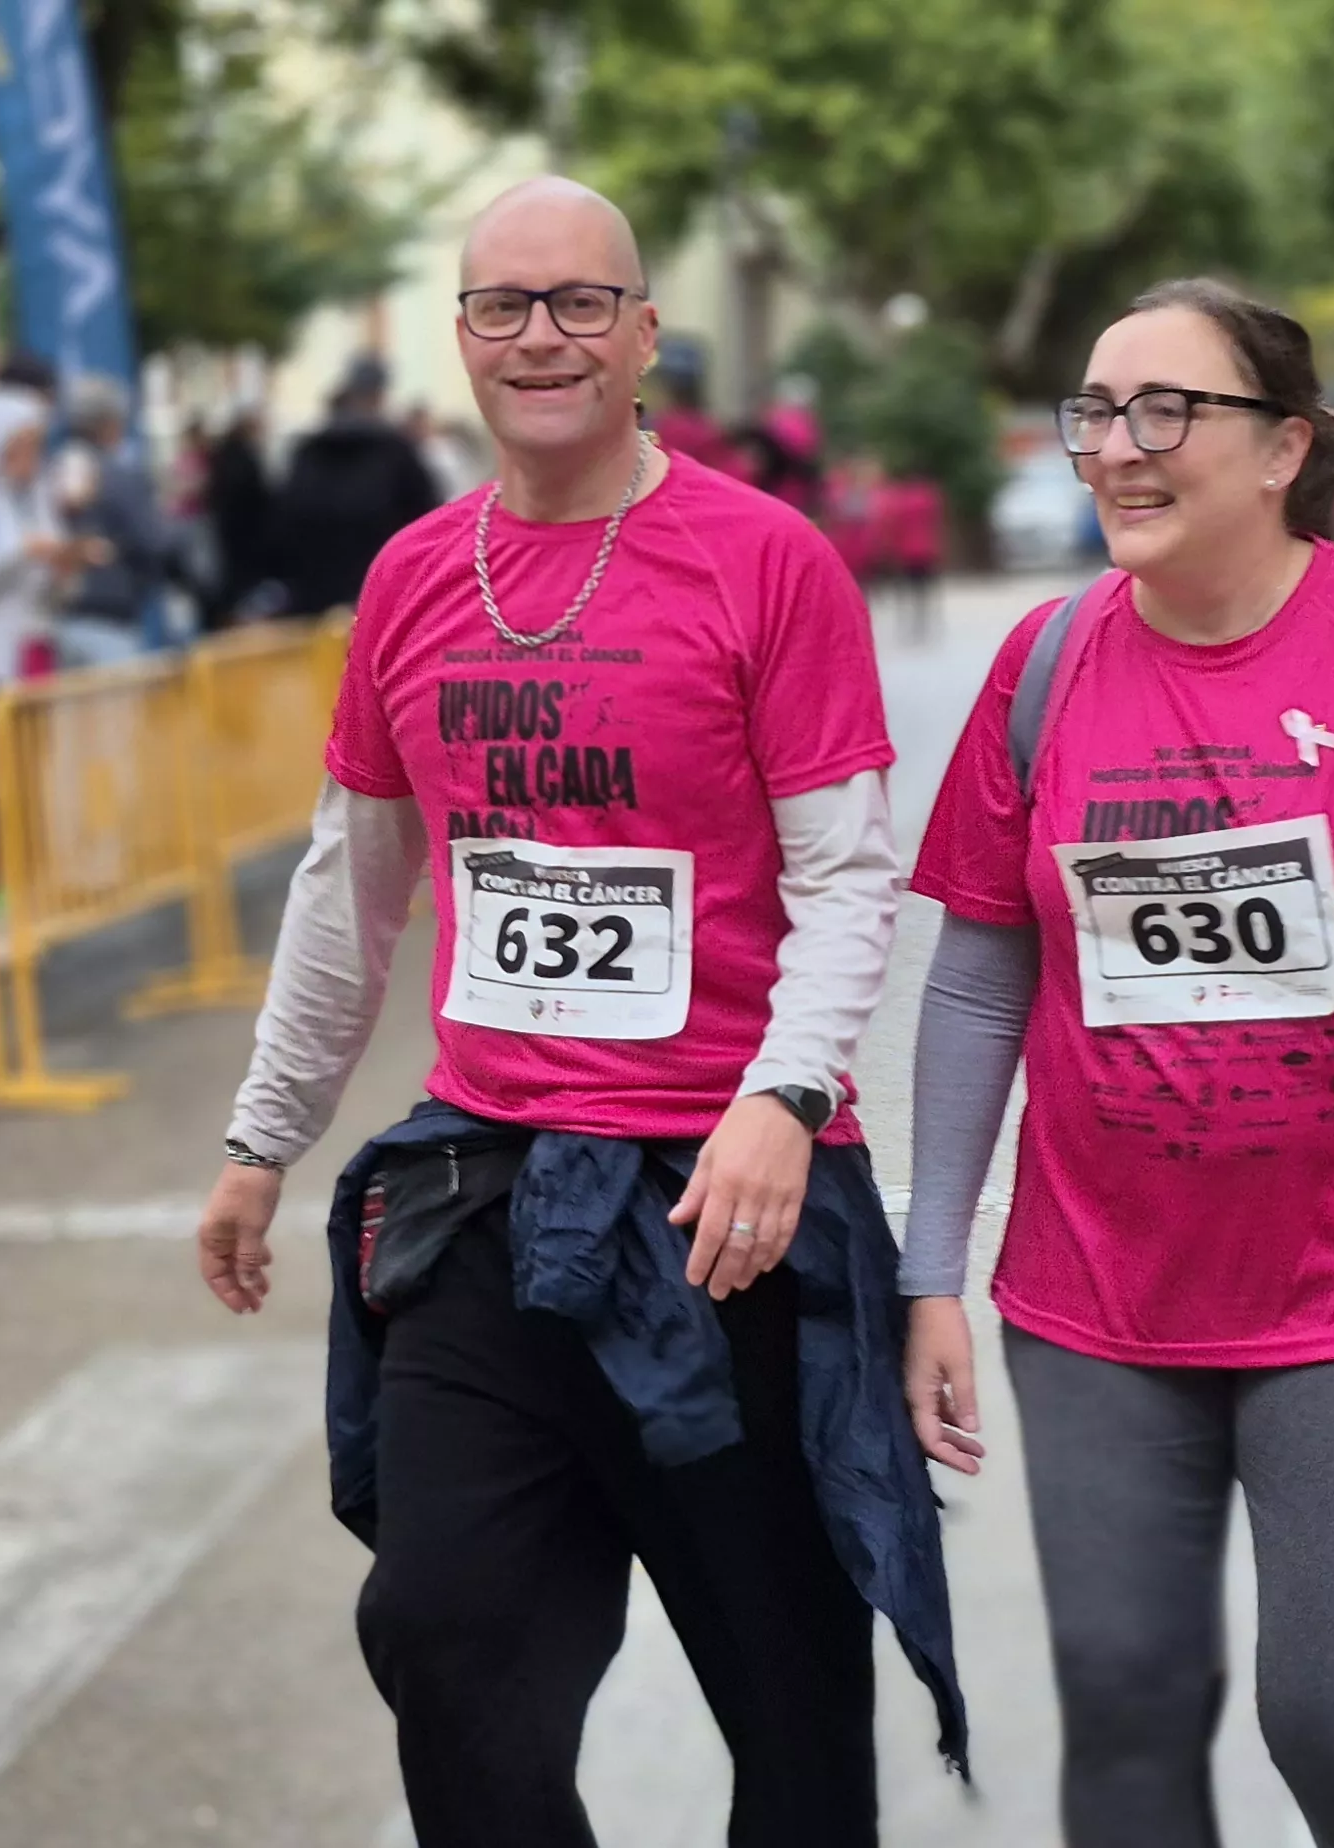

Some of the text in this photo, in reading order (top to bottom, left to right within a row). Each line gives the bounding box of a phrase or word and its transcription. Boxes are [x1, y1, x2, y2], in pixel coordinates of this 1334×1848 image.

[438, 680, 564, 743] UNIDOS
[486, 746, 637, 808] EN CADA
[576, 882, 664, 904] CÁNCER
[1091, 861, 1306, 893] CONTRA EL CÁNCER
[495, 906, 635, 982] 632
[1131, 897, 1286, 966] 630
